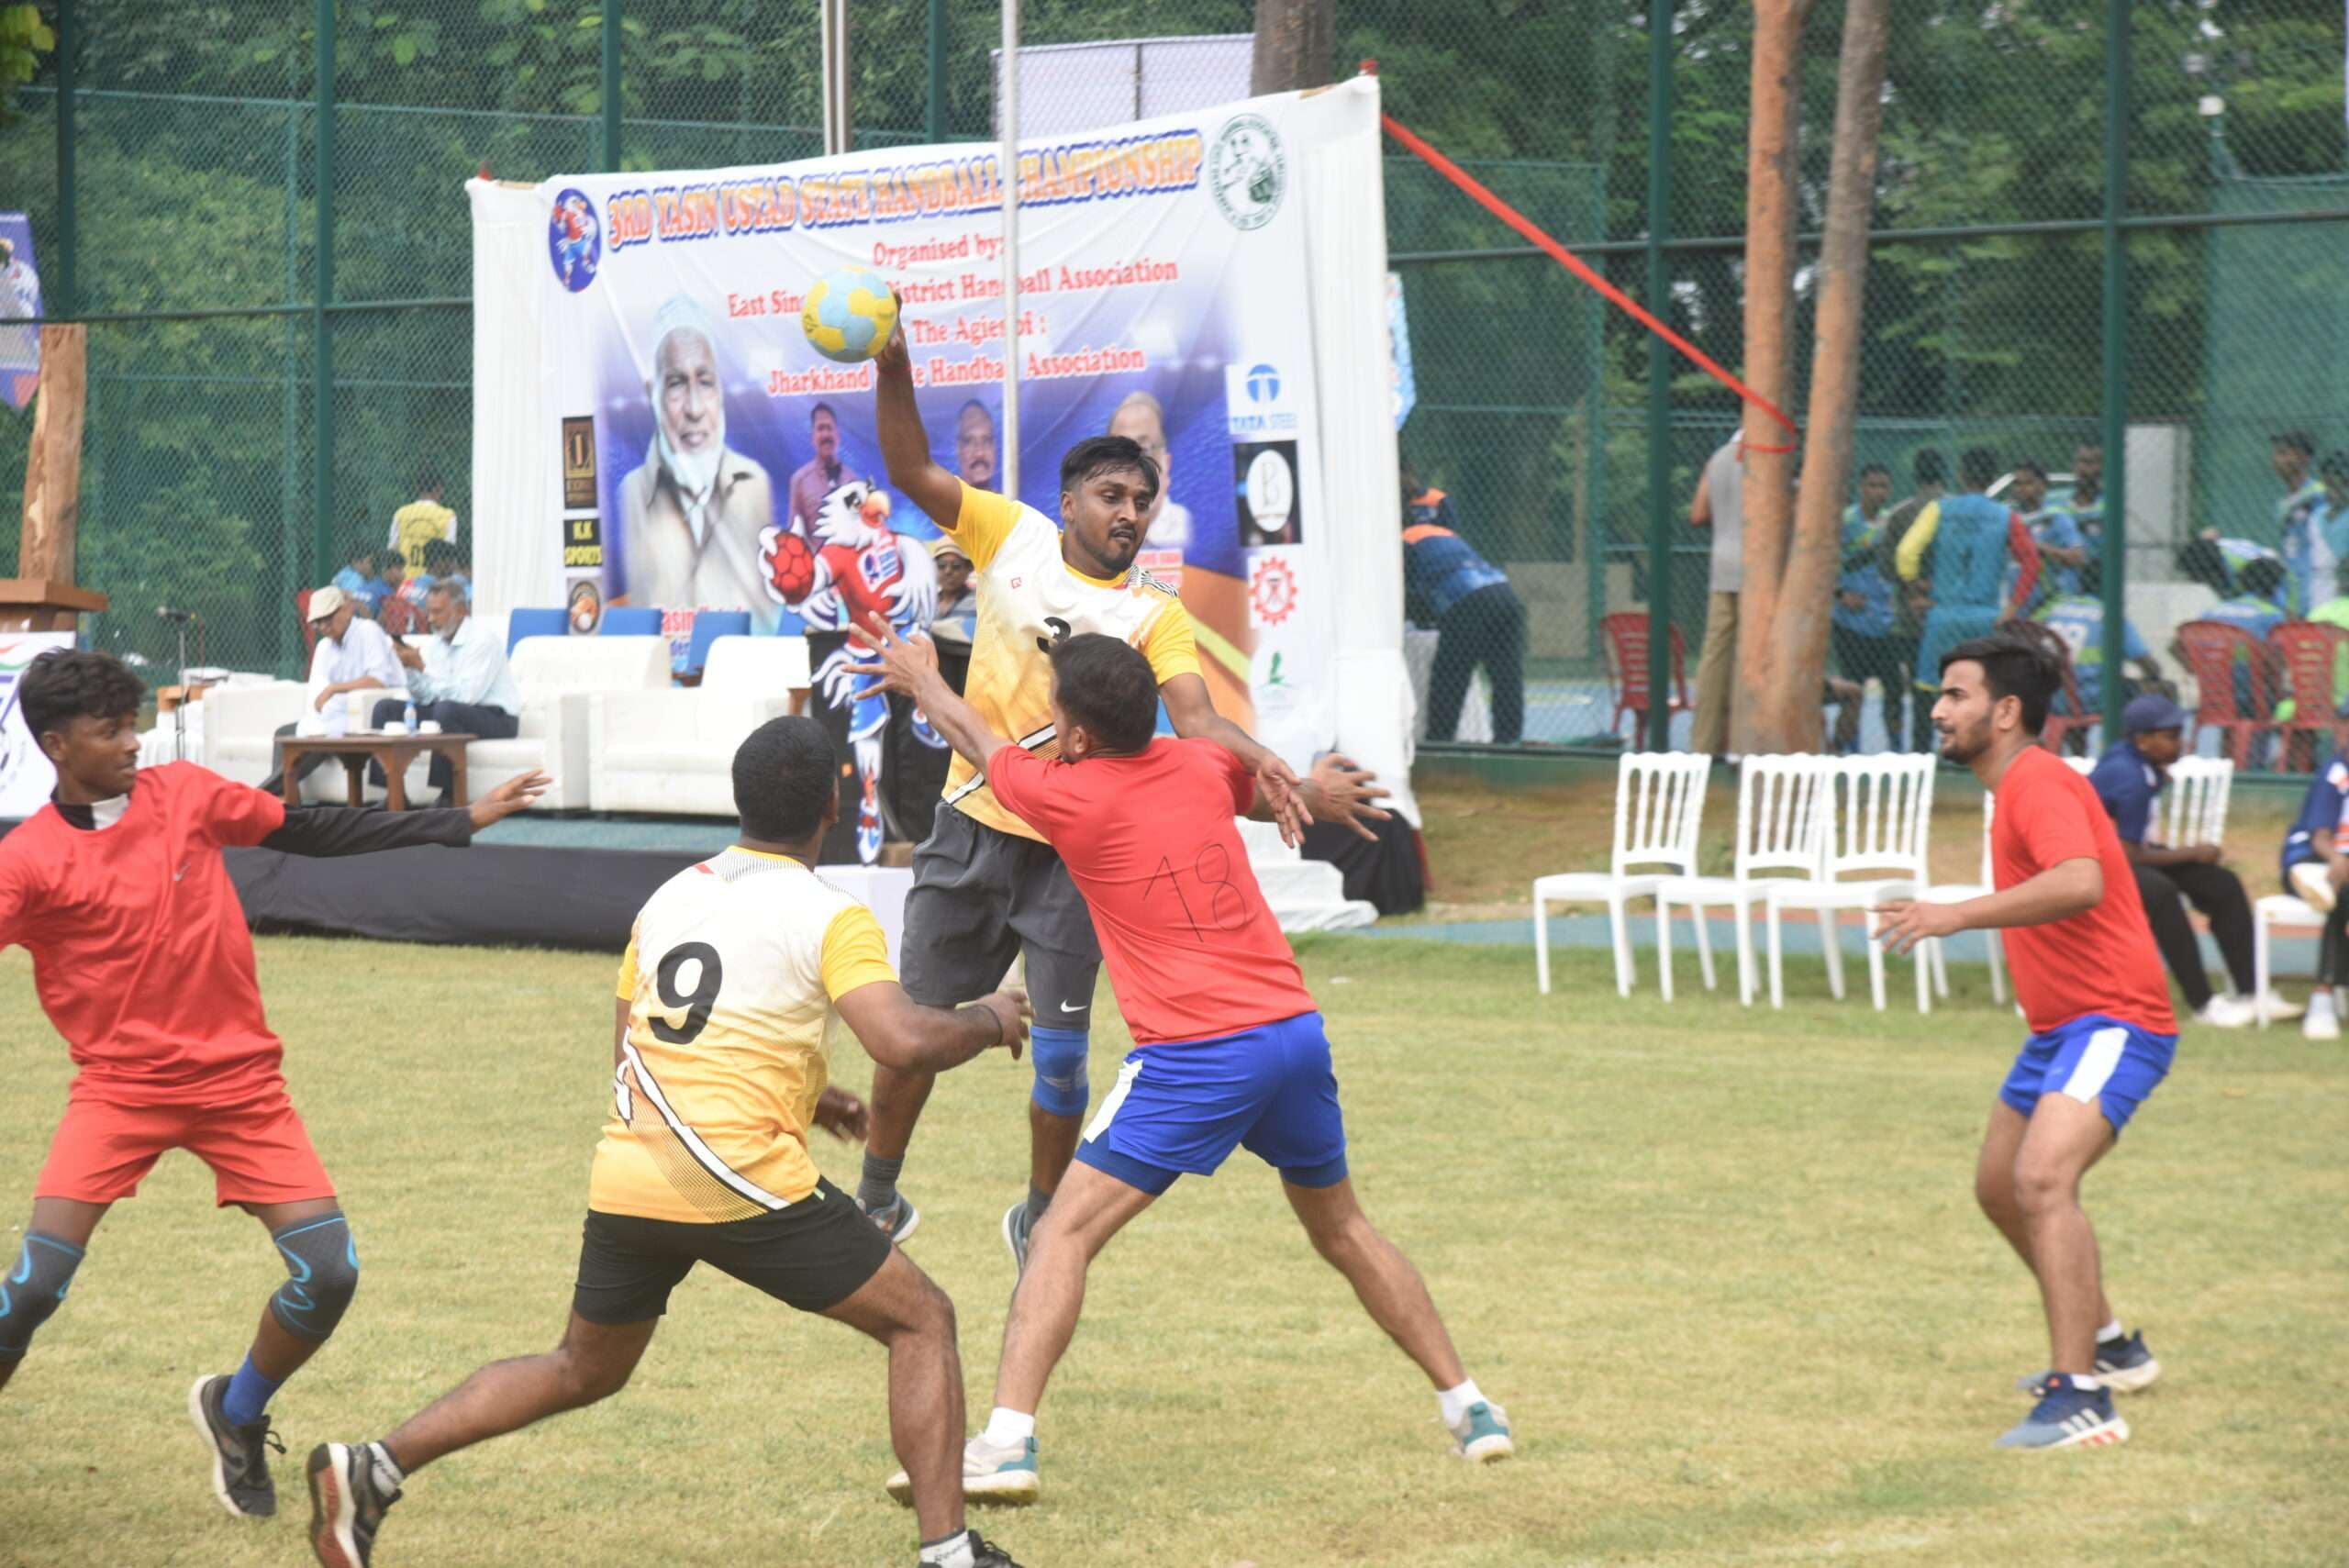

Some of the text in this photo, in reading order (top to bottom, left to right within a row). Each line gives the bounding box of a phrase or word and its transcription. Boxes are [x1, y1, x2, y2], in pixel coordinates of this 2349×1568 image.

[609, 189, 652, 250] 3RD
[654, 184, 719, 241] YASIN
[720, 176, 796, 235] USTAD
[800, 170, 870, 228] STATE
[874, 154, 1003, 223] HANDBALL
[1016, 128, 1203, 208] HAMPIONSHIP
[874, 235, 968, 269] Organised
[728, 293, 765, 318] East
[1058, 258, 1178, 291] Association
[912, 319, 948, 343] The
[768, 365, 871, 395] Jharkhand
[930, 356, 1005, 385] Handba
[1027, 346, 1146, 377] Association
[662, 609, 695, 632] asin
[1141, 842, 1247, 943] 18
[648, 941, 723, 1045] 9
